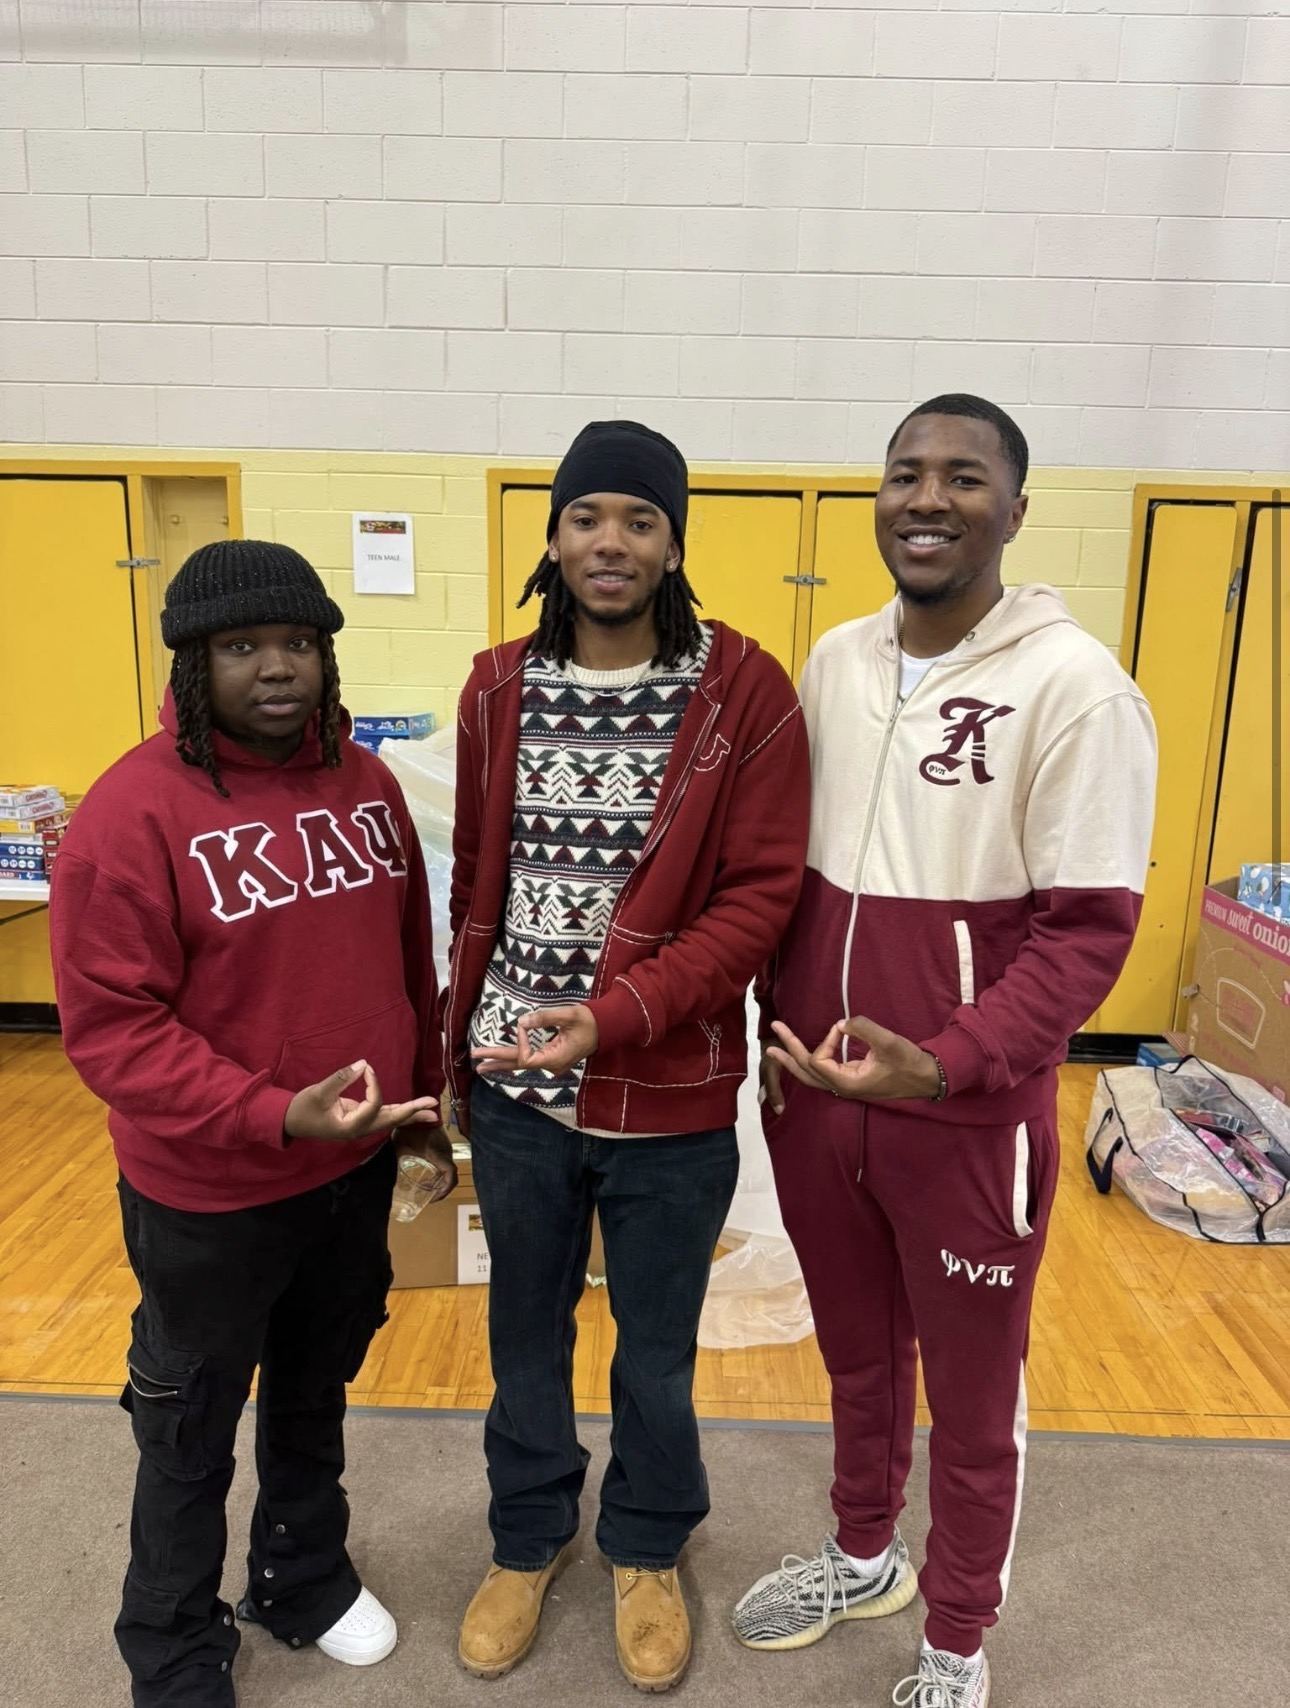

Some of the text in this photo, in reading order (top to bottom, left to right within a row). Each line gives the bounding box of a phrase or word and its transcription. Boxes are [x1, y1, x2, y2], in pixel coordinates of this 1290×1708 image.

[367, 553, 400, 561] TEEN MALE
[1226, 909, 1254, 935] sweet
[477, 1252, 489, 1260] NE
